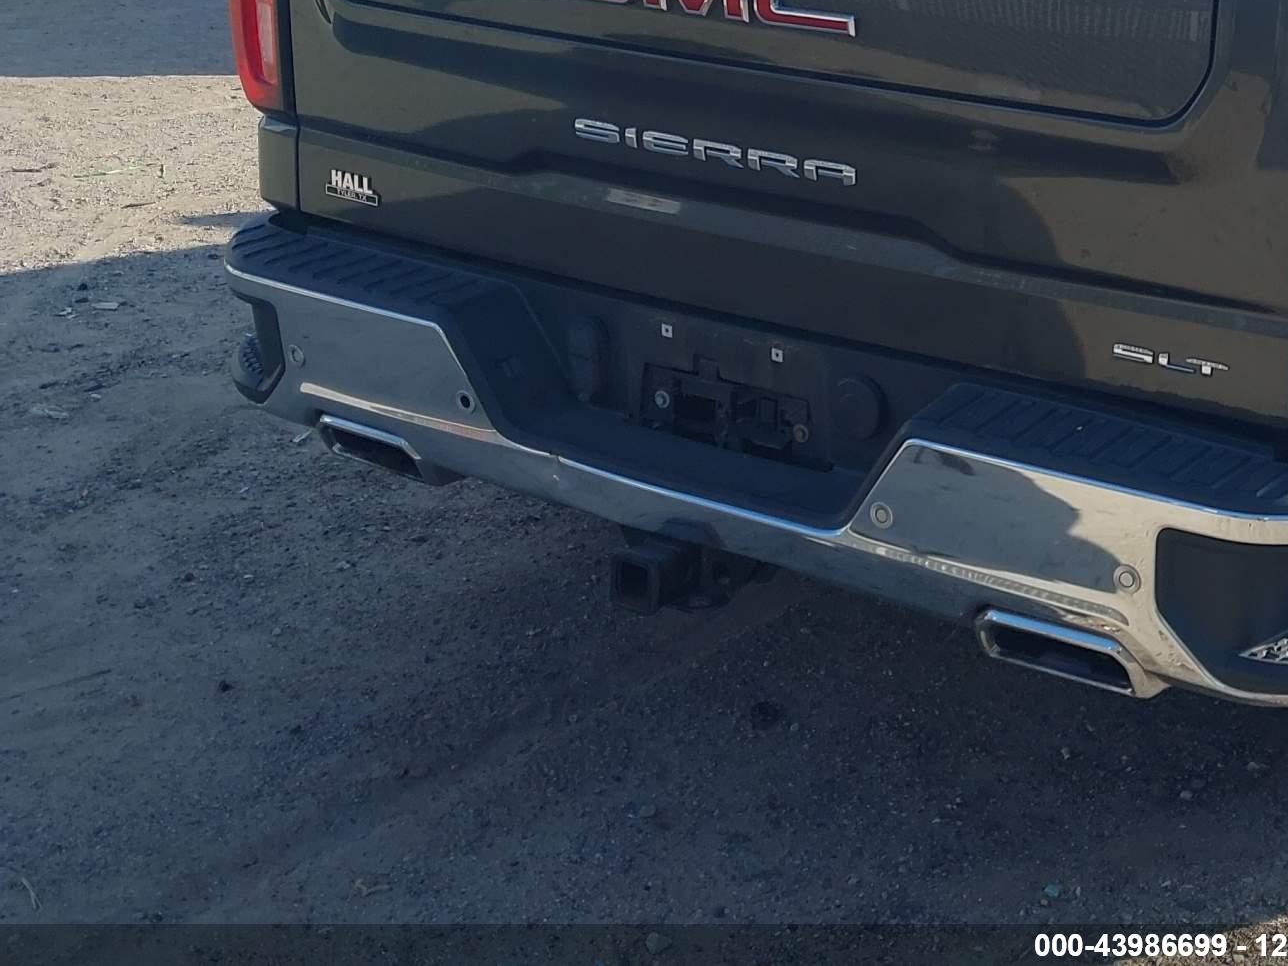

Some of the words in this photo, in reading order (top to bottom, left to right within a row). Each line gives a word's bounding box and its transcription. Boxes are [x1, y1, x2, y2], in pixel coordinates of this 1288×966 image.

[574, 118, 857, 186] SIERRA
[331, 169, 373, 195] HALL
[1113, 343, 1229, 375] SLT
